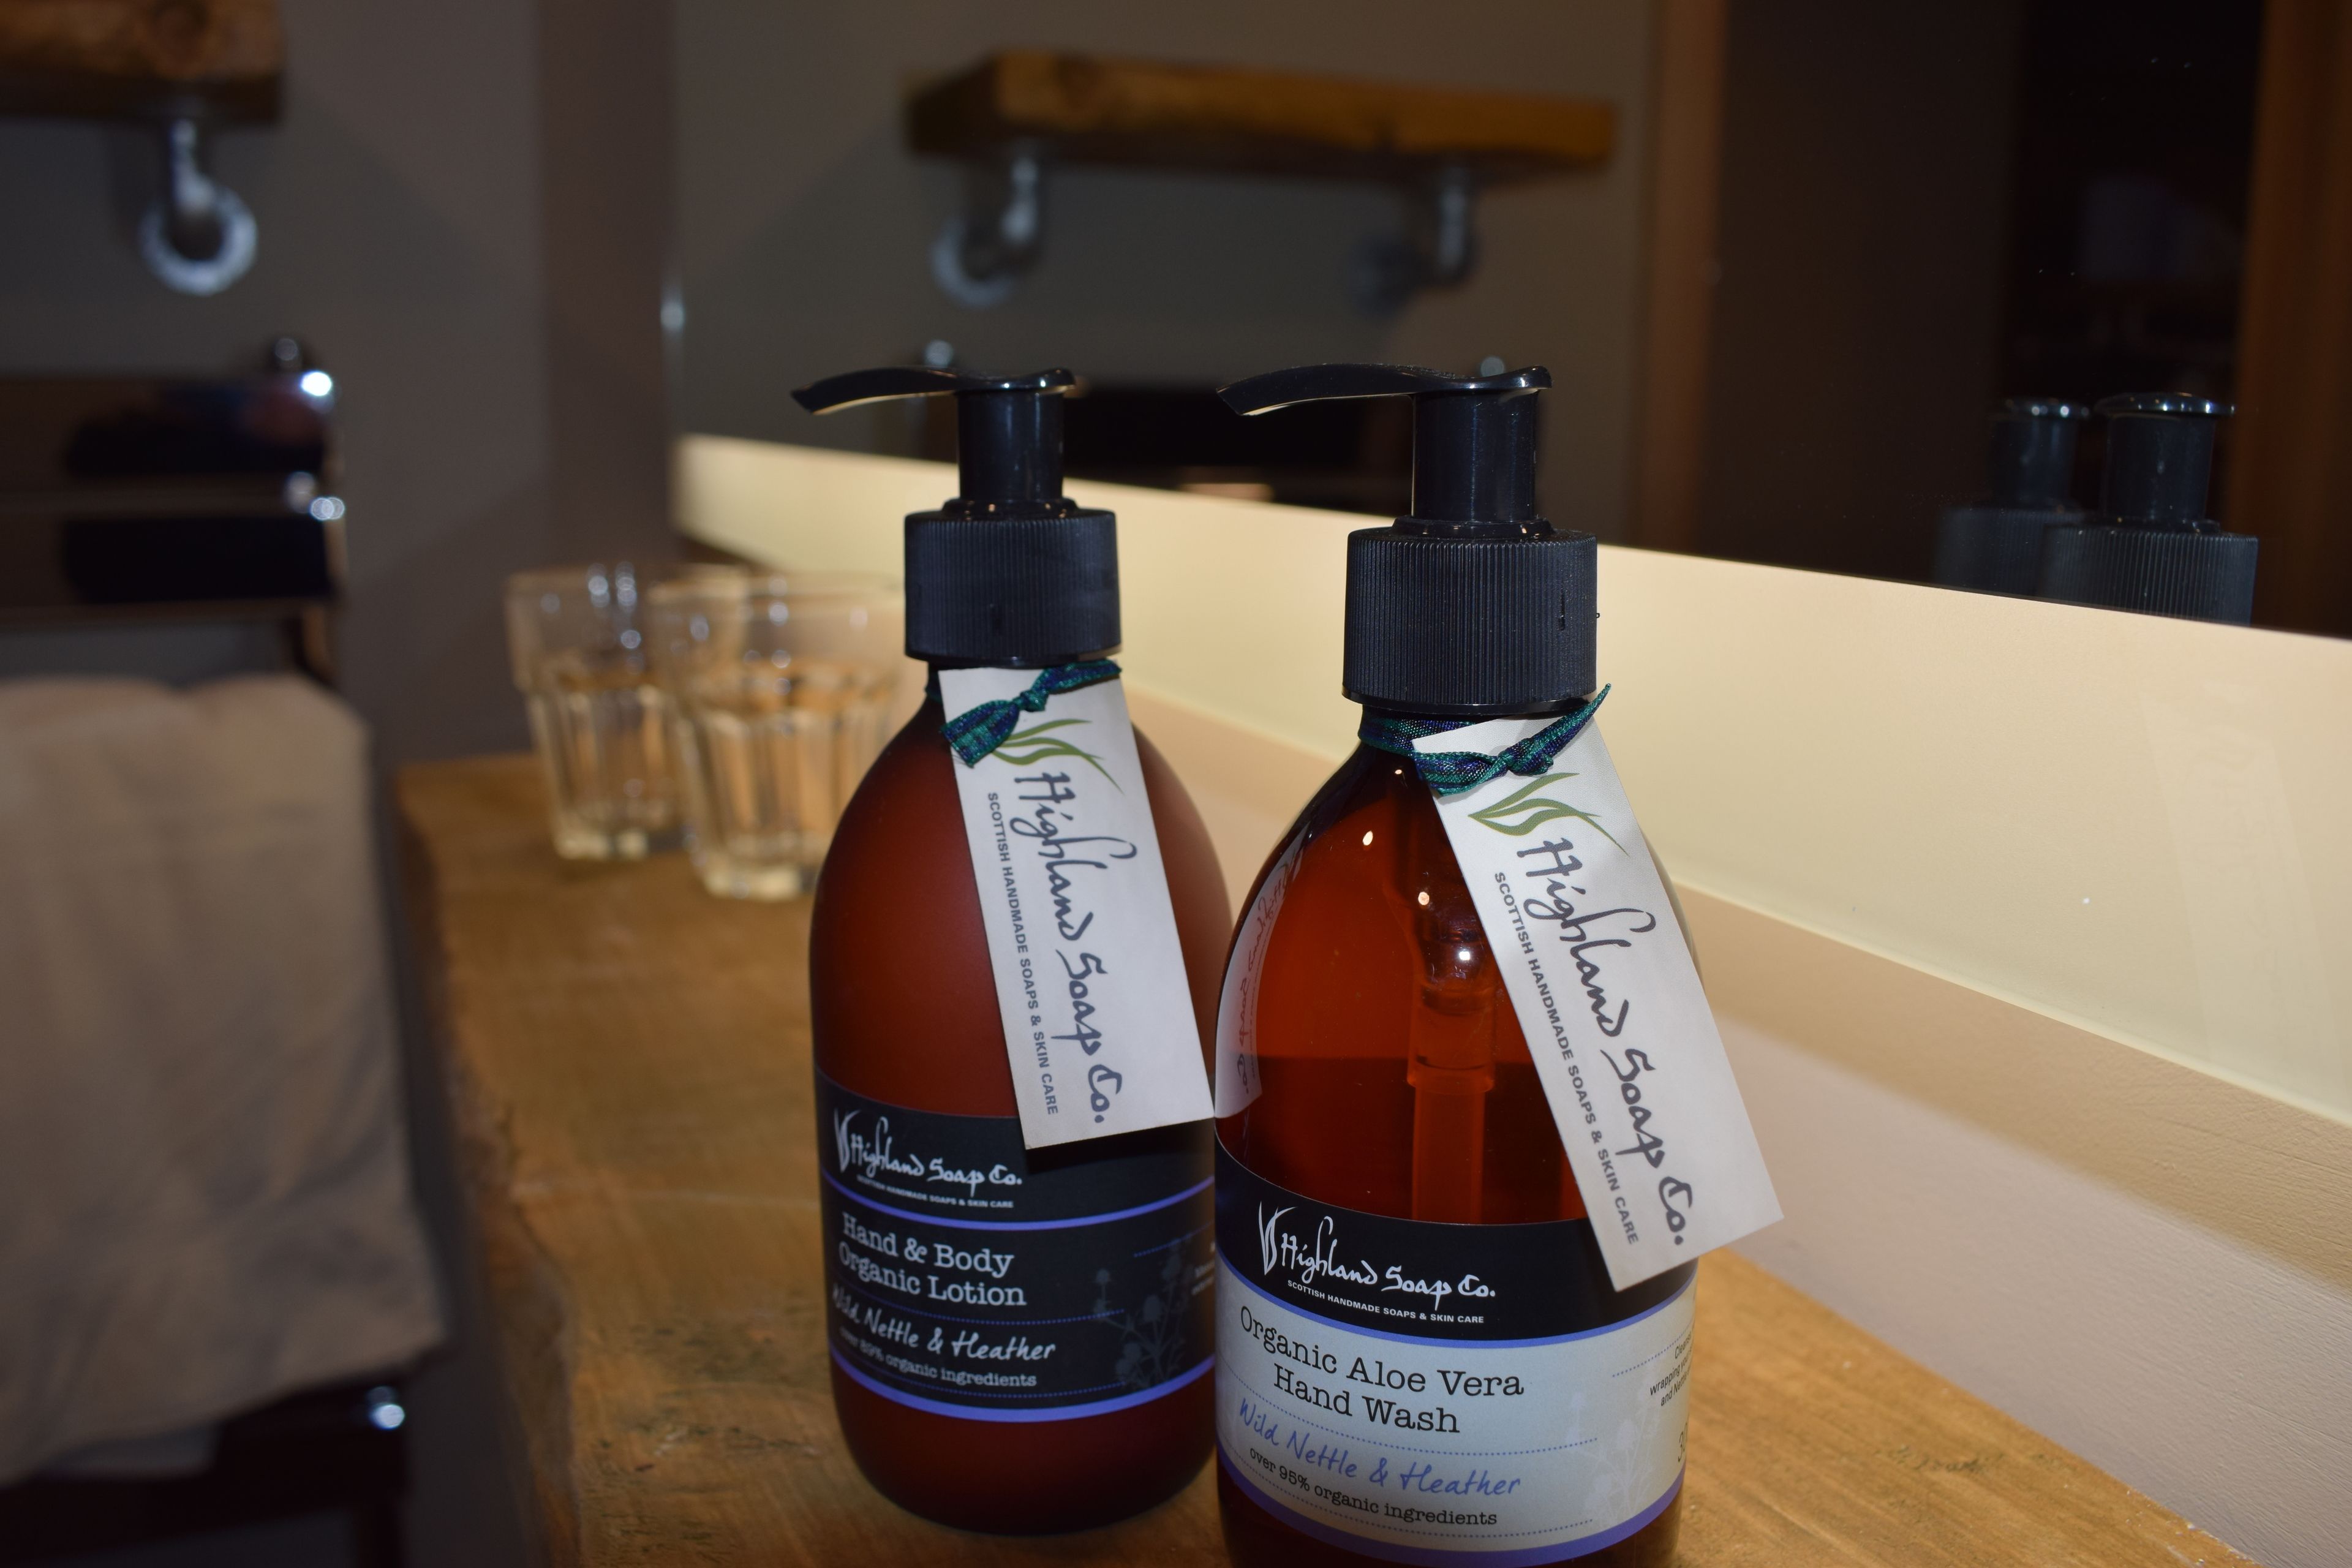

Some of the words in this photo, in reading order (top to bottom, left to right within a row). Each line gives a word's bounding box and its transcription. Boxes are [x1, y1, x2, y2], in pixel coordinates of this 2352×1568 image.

[988, 793, 1010, 862] SCOTTISH
[1009, 772, 1137, 941] Highland
[1002, 867, 1028, 953] HANDMADE
[1020, 958, 1039, 1009] SOAPS
[1050, 949, 1109, 1057] Soap
[1031, 1015, 1041, 1027] &
[1034, 1031, 1050, 1068] SKIN
[1516, 837, 1656, 1037] Highland
[1599, 1048, 1665, 1169] Soap
[1658, 1176, 1693, 1245] Co.
[1494, 872, 1534, 954] SCOTTISH
[1528, 958, 1574, 1061] HANDMADE
[1568, 1065, 1596, 1125] SOAPS
[1591, 1130, 1602, 1144] &
[1598, 1148, 1620, 1191] SKIN
[1615, 1197, 1639, 1245] CARE
[1042, 1073, 1058, 1115] CARE
[1088, 1064, 1123, 1123] Co.
[850, 1116, 925, 1178] Highland
[927, 1158, 985, 1197] Soap
[989, 1164, 1022, 1185] Co.
[929, 1194, 956, 1205] SOAPS
[967, 1199, 988, 1207] SKIN
[990, 1200, 1014, 1208] CARE
[839, 1241, 921, 1295] Organic
[927, 1275, 1027, 1305] Lotion
[842, 1212, 899, 1257] Hand
[904, 1237, 927, 1264] &
[933, 1243, 1014, 1278] Body
[1281, 1216, 1378, 1284] Highland
[1381, 1265, 1452, 1311] Soap
[1458, 1274, 1496, 1297] Co.
[864, 1307, 919, 1348] Nettle
[927, 1327, 944, 1354] &
[951, 1330, 1057, 1360] Heather
[1287, 1280, 1325, 1300] SCOTTISH
[1327, 1295, 1381, 1313] HANDMADE
[1383, 1307, 1416, 1320] SOAPS
[1430, 1313, 1454, 1322] SKIN
[886, 1354, 938, 1378] organic
[941, 1367, 1037, 1387] ingredients
[1240, 1306, 1337, 1374] Organic
[1346, 1357, 1427, 1393] Aloe
[1436, 1370, 1525, 1396] Vera
[1649, 1364, 1681, 1396] wrapping
[1273, 1363, 1353, 1417] Hand
[1362, 1395, 1460, 1434] Wash
[1660, 1385, 1673, 1406] and
[1239, 1398, 1280, 1446] Wild
[1286, 1430, 1357, 1478] Nettle
[1370, 1457, 1389, 1487] &
[1400, 1461, 1521, 1496] Heather
[1250, 1447, 1276, 1474] over
[1279, 1465, 1311, 1492] 95%
[1314, 1485, 1379, 1514] organic
[1384, 1503, 1498, 1526] ingredients
